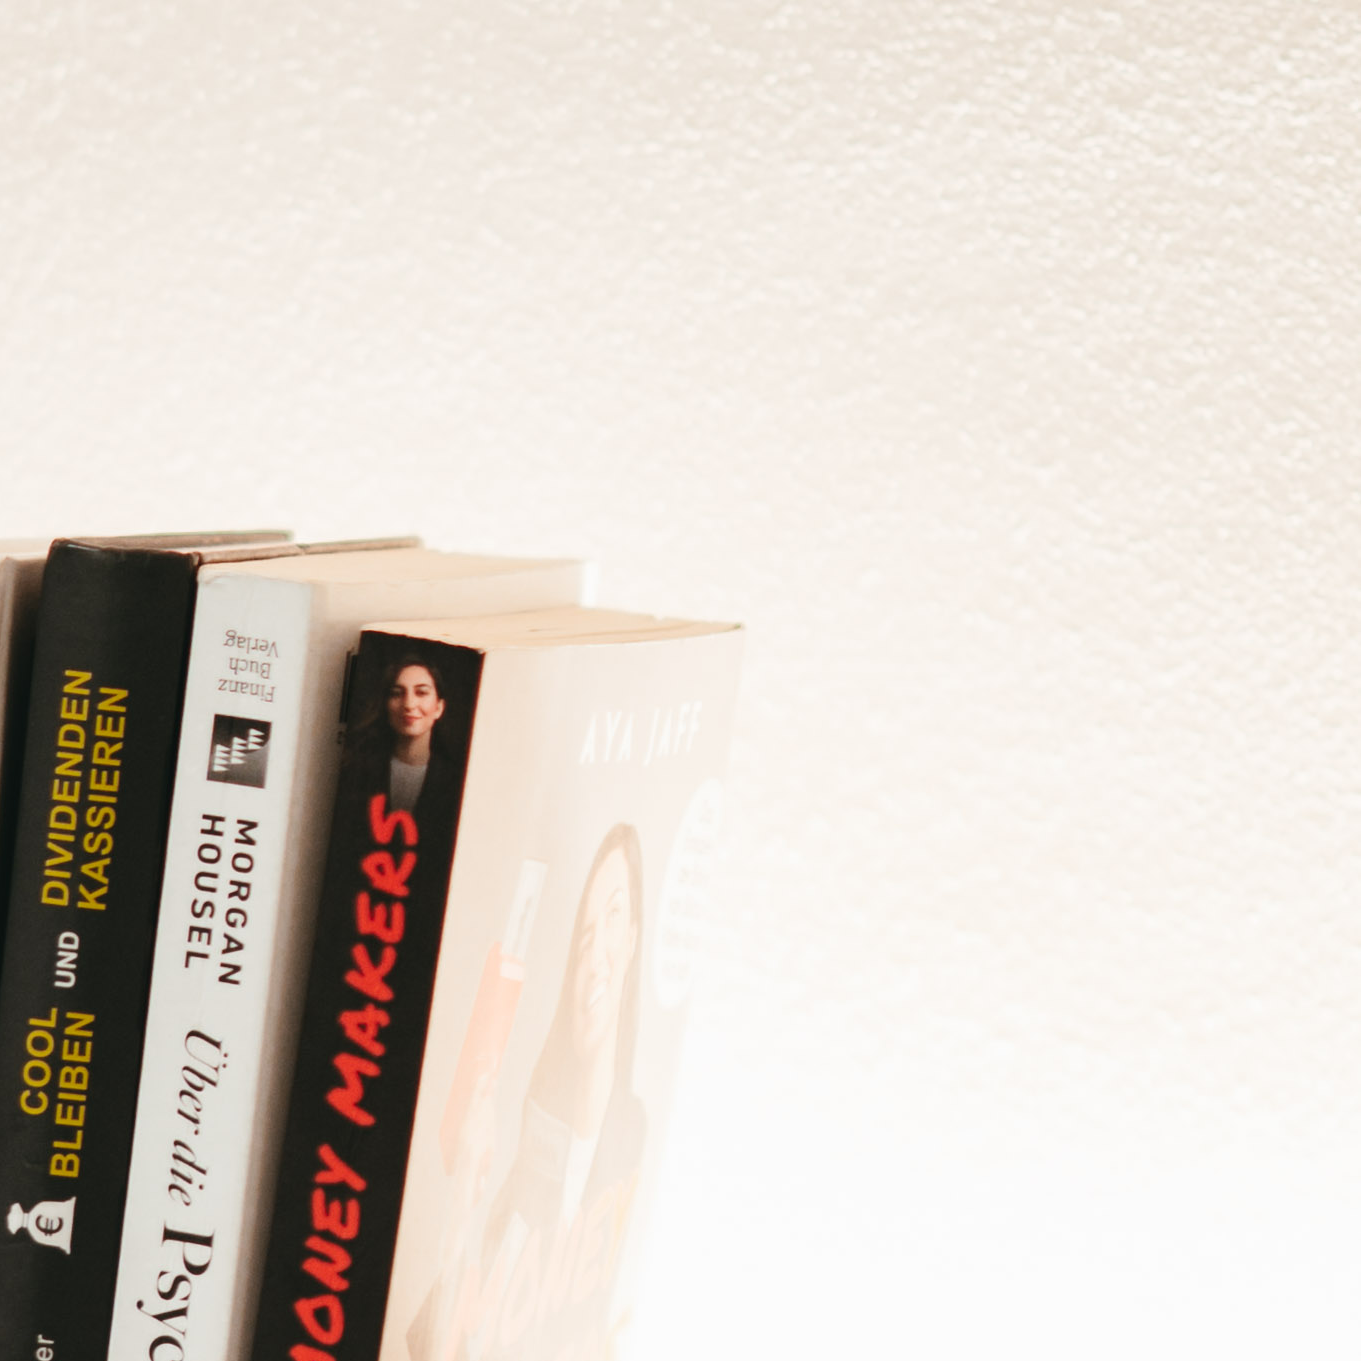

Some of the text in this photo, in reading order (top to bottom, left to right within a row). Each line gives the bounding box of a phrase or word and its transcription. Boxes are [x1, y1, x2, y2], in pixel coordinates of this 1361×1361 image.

[218, 676, 275, 702] Finanz
[223, 630, 278, 657] Verlag
[229, 658, 271, 679] Buch
[41, 670, 94, 909] DIVIDENDEN
[77, 687, 128, 910] KASSIEREN
[185, 814, 228, 968] HOUSEL
[216, 816, 258, 985] MORGAN
[54, 932, 79, 987] UND
[326, 794, 419, 1127] MAKERS
[20, 1008, 60, 1117] COOL
[48, 1009, 95, 1177] BLEIBEN
[176, 1029, 229, 1136] Über
[168, 1139, 208, 1206] die
